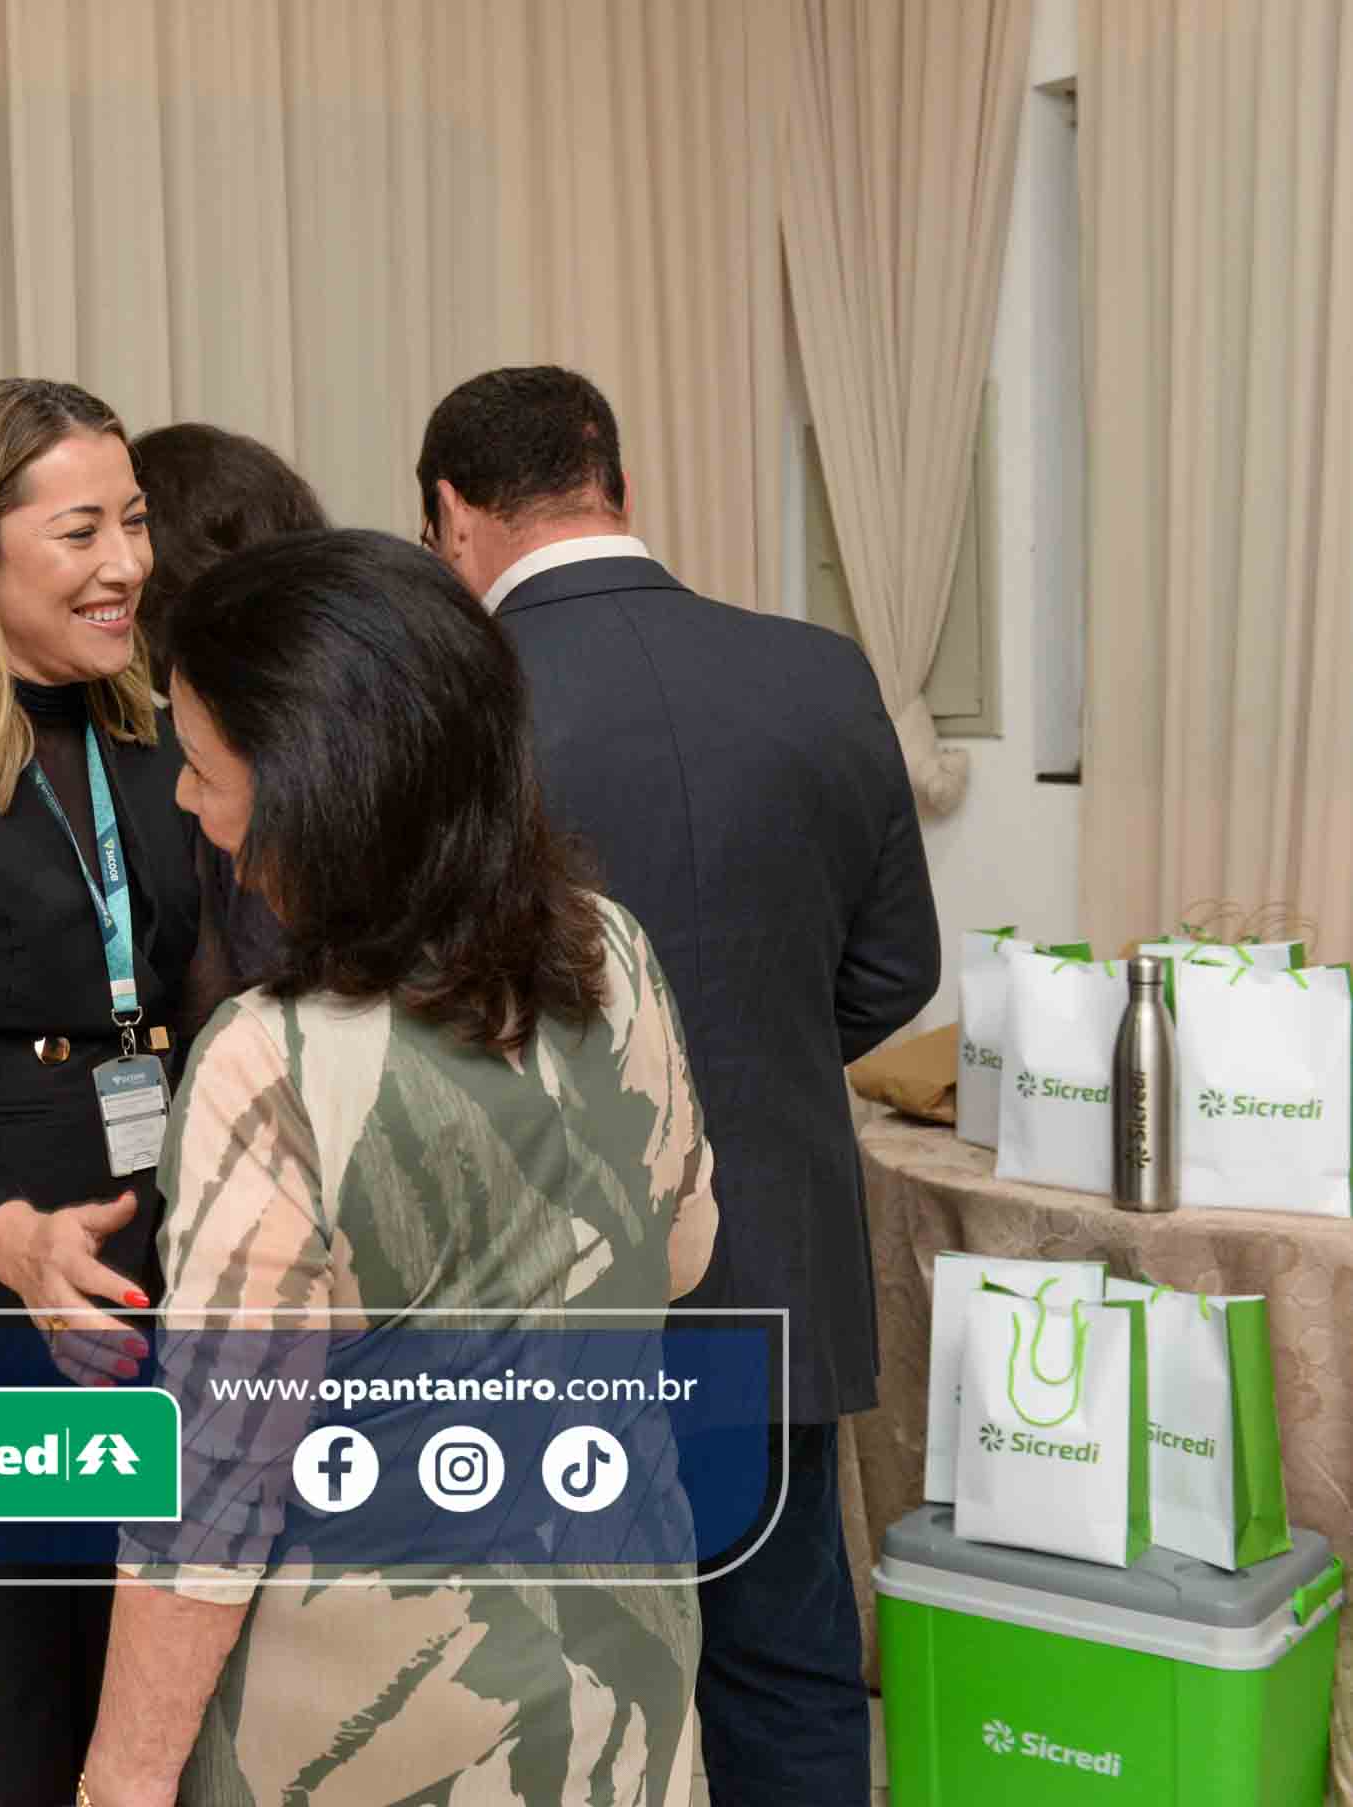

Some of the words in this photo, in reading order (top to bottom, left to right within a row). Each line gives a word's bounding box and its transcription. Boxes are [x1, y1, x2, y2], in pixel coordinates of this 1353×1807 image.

[1042, 1077, 1111, 1103] Sicred
[1232, 1095, 1324, 1120] Sicredi
[1010, 1432, 1101, 1464] Sicredi
[1021, 1732, 1122, 1777] Sicredi
